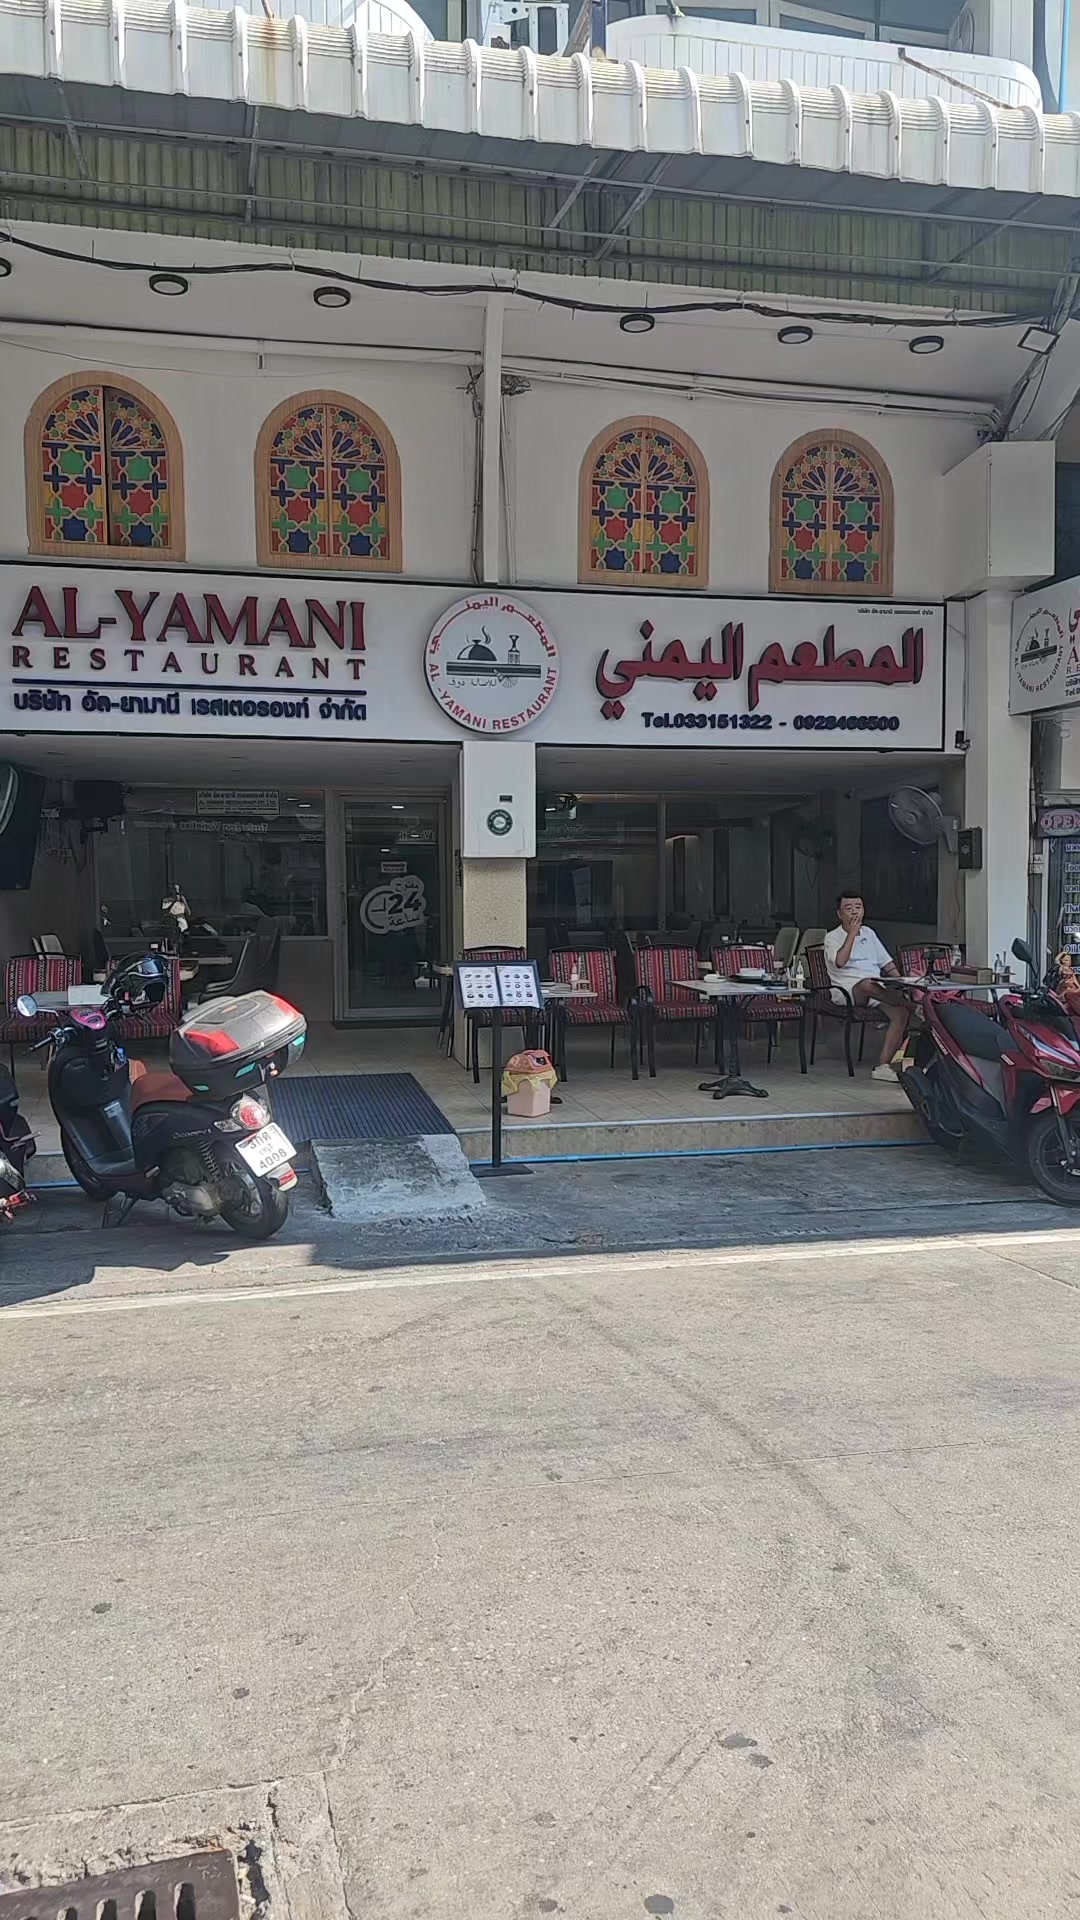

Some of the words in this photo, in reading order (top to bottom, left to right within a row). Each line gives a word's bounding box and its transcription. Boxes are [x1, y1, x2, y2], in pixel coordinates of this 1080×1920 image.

[12, 585, 367, 651] AL-YAMANI
[12, 645, 367, 680] RESTAURANT
[595, 618, 743, 721] اليمني
[748, 623, 925, 711] المطعم
[13, 688, 71, 711] บริษัท
[81, 690, 181, 714] อัล-ยามานี
[318, 696, 367, 721] จำกัด
[492, 667, 557, 730] RESTAURANT
[641, 712, 772, 730] Tel.033151322
[793, 714, 900, 731] 0928466500
[388, 891, 422, 915] 24
[259, 1148, 287, 1169] 4008
